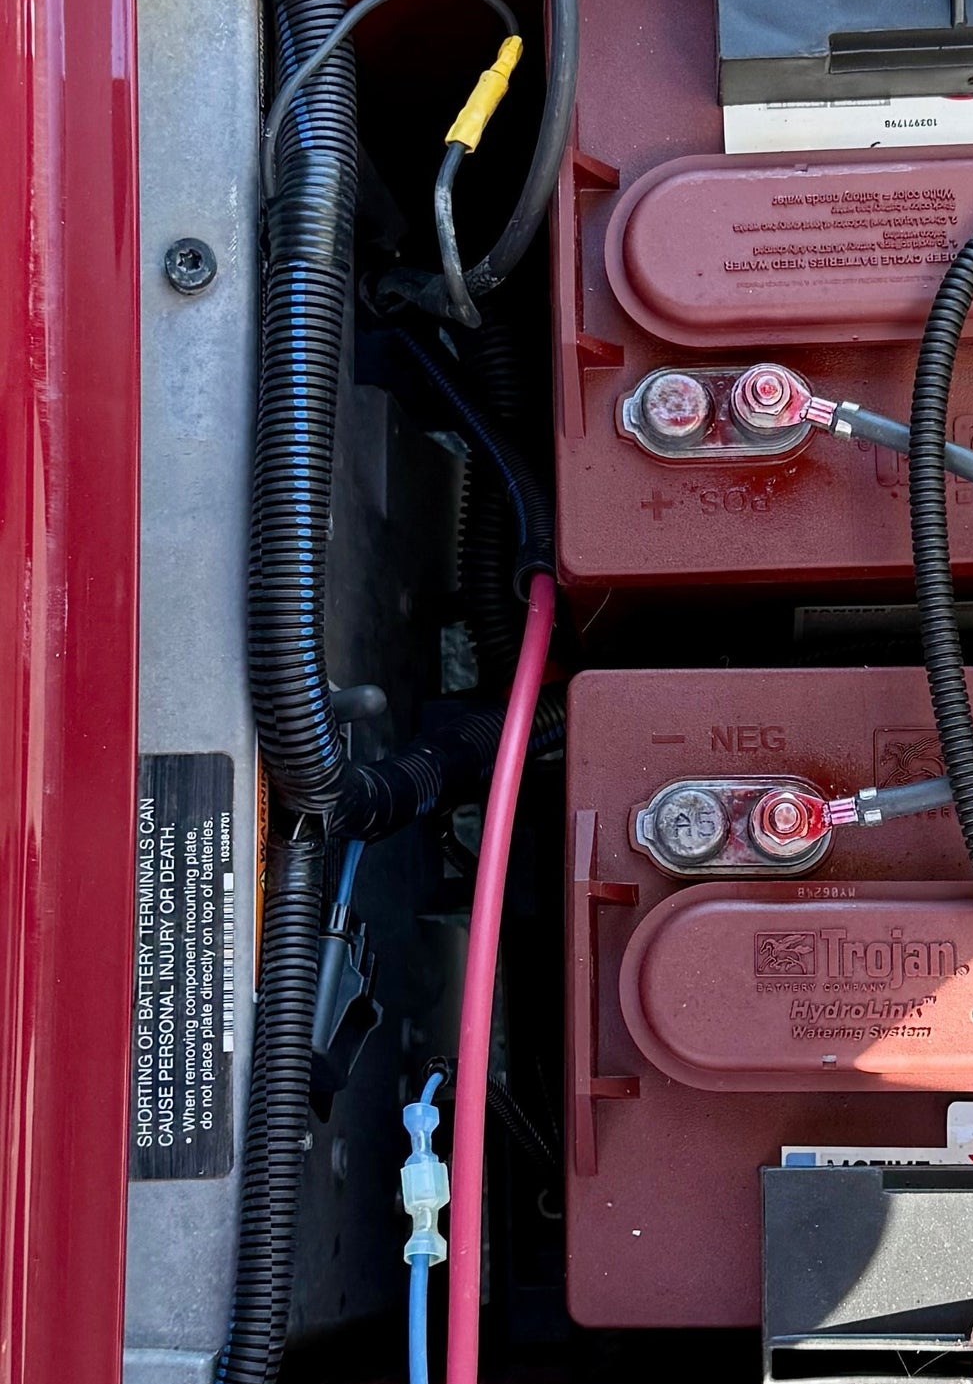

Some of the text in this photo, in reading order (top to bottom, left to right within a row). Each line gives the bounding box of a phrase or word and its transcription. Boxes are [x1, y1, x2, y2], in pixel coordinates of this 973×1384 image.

[885, 118, 937, 128] 103971798
[724, 261, 768, 272] WATER
[771, 258, 804, 270] NEED
[809, 256, 878, 269] BATTERIES
[881, 254, 921, 266] CYCLE
[699, 491, 771, 515] POS
[711, 725, 787, 753] NEG
[221, 812, 230, 863] 103384701
[138, 799, 155, 1147] SHORTING OF BATTERY TERMINALS CAN
[183, 827, 200, 1131] When removing component mounting plate,
[200, 817, 215, 1129] do not place plate directly on top of batteries.
[159, 823, 175, 1146] CAUSE PERSONAL INJURY OR DEATH.
[756, 982, 887, 992] BATTERY COMPANY
[791, 1025, 931, 1041] Watering System
